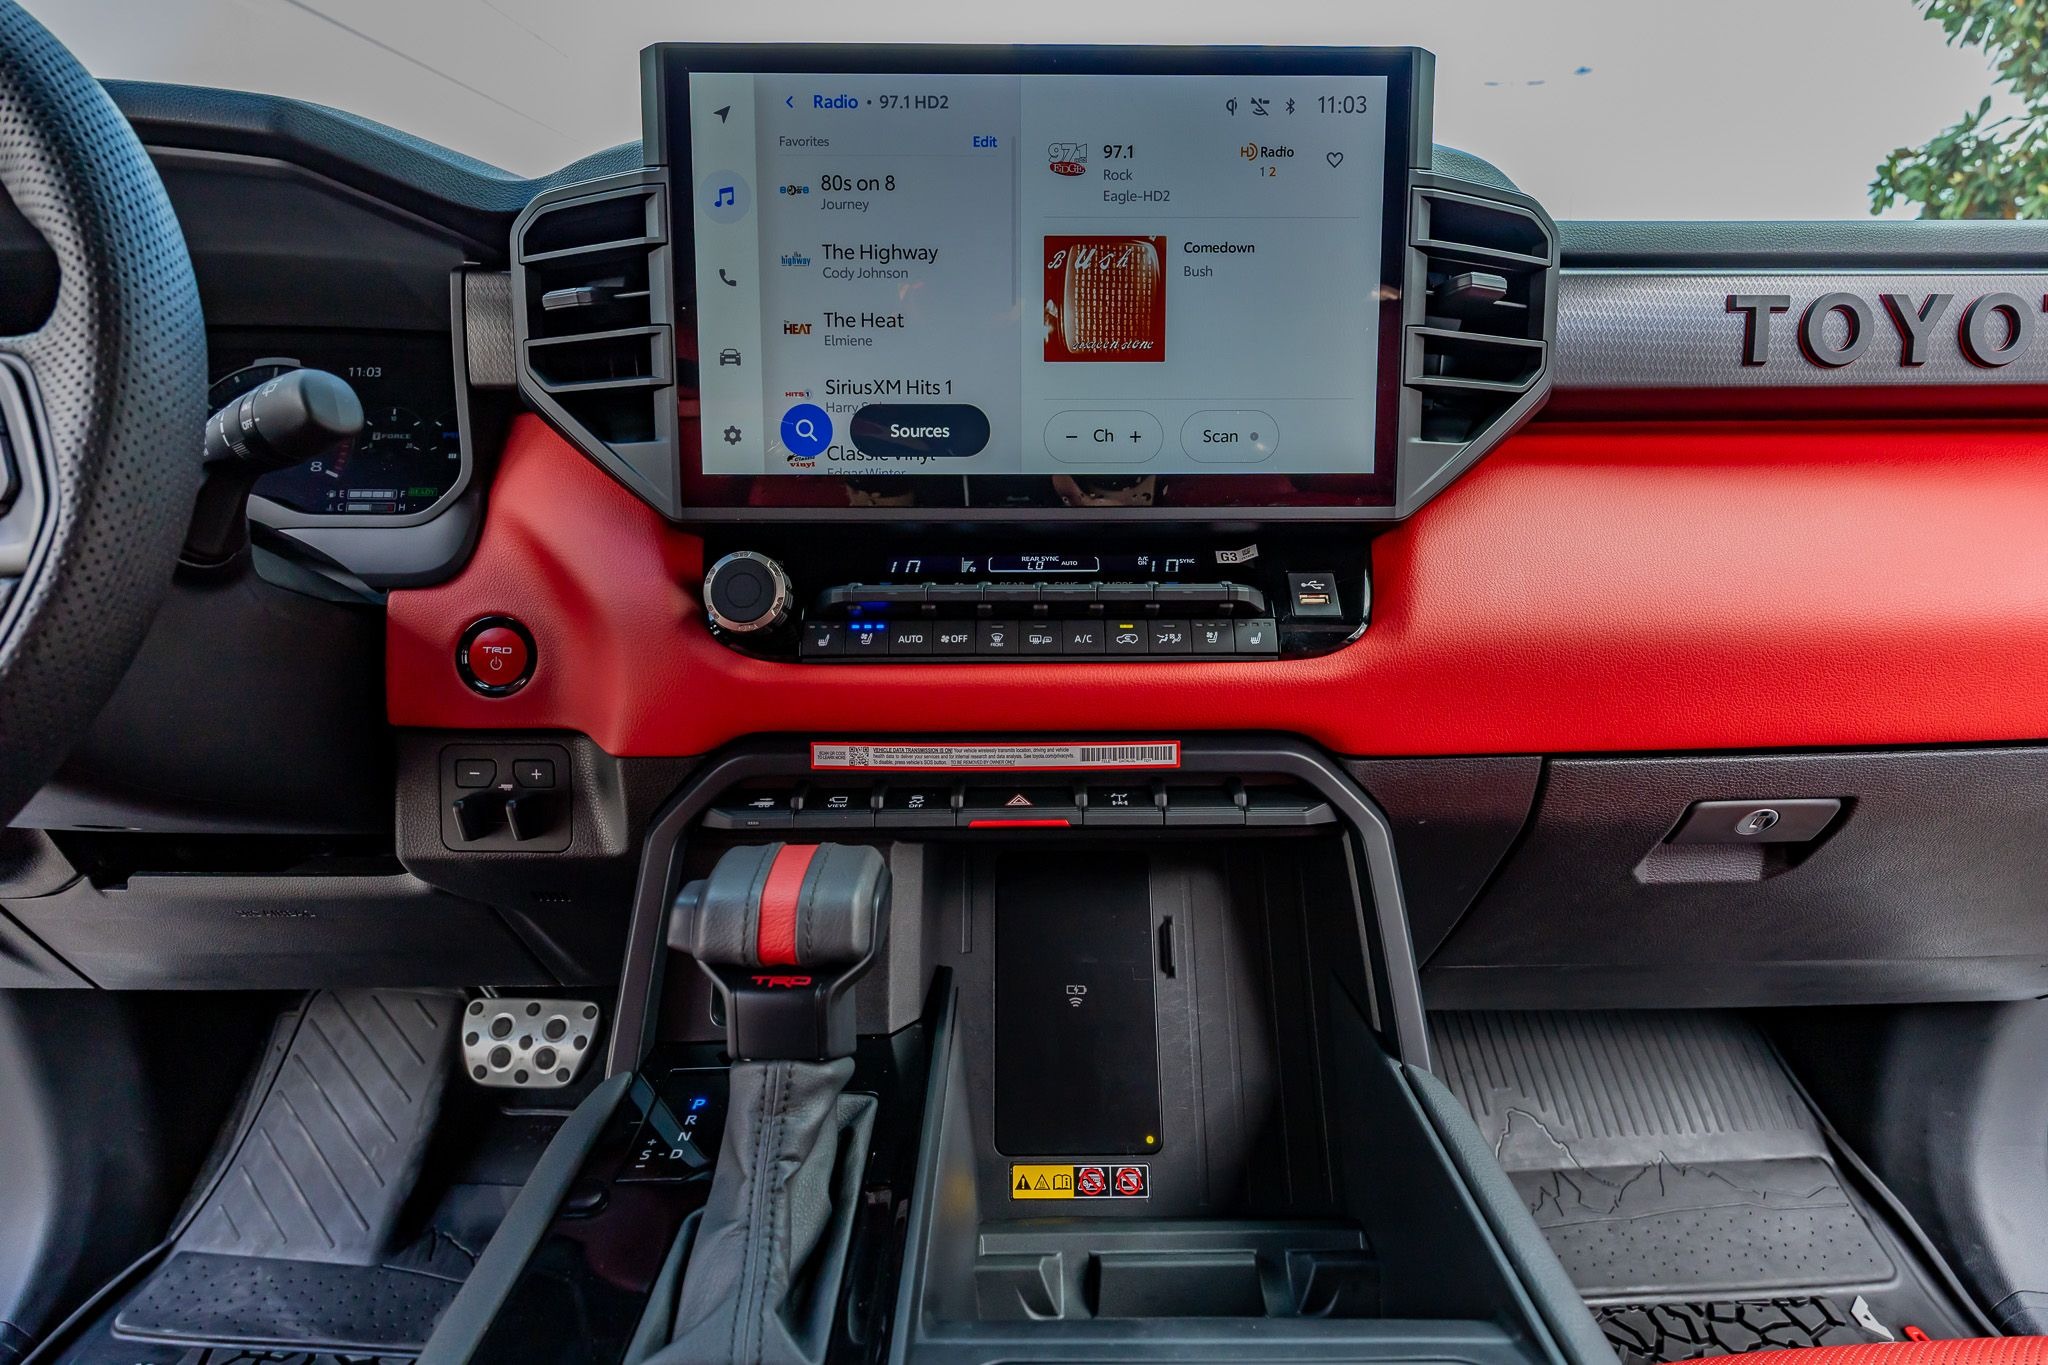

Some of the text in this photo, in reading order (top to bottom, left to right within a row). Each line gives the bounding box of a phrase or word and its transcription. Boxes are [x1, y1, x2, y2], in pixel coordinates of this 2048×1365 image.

[813, 94, 949, 110] Radio 97.1 HD2
[1318, 95, 1367, 114] 11:03
[779, 136, 830, 148] Favorites
[973, 136, 998, 149] Edit
[1103, 145, 1135, 159] 97.1
[1260, 145, 1295, 158] Radio
[1103, 168, 1133, 181] Rock
[1260, 167, 1276, 177] 1 2
[821, 174, 852, 192] 80s
[857, 178, 880, 192] on
[885, 174, 896, 192] 8
[1103, 190, 1171, 205] Eagle-HD2
[820, 199, 870, 213] Journey
[822, 244, 939, 264] The Highway
[1184, 241, 1256, 254] Comedown
[781, 255, 811, 267] highway
[823, 267, 909, 281] Cody Johnson
[1184, 265, 1213, 277] Bush
[824, 312, 905, 329] The Heat
[783, 323, 813, 335] HEAT
[1727, 291, 2048, 369] TOYO
[824, 335, 873, 347] Elmiene
[349, 367, 382, 378] 11:03
[825, 379, 953, 396] SiriusXM Hits 1
[826, 402, 859, 415] Harry
[890, 424, 950, 438] Sources
[1093, 428, 1114, 443] Ch
[1203, 429, 1239, 444] Scan
[310, 461, 322, 472] 8
[339, 490, 345, 498] E
[400, 490, 406, 498] F
[337, 503, 406, 512] C H
[1221, 552, 1238, 562] G3
[898, 634, 923, 643] AUTO
[951, 634, 968, 643] OFF
[1074, 634, 1093, 644] A/C
[483, 646, 512, 655] TRD
[752, 975, 812, 988] TRD
[693, 1099, 706, 1110] P
[684, 1114, 697, 1126] R
[677, 1131, 692, 1142] N
[639, 1149, 684, 1161] S D
